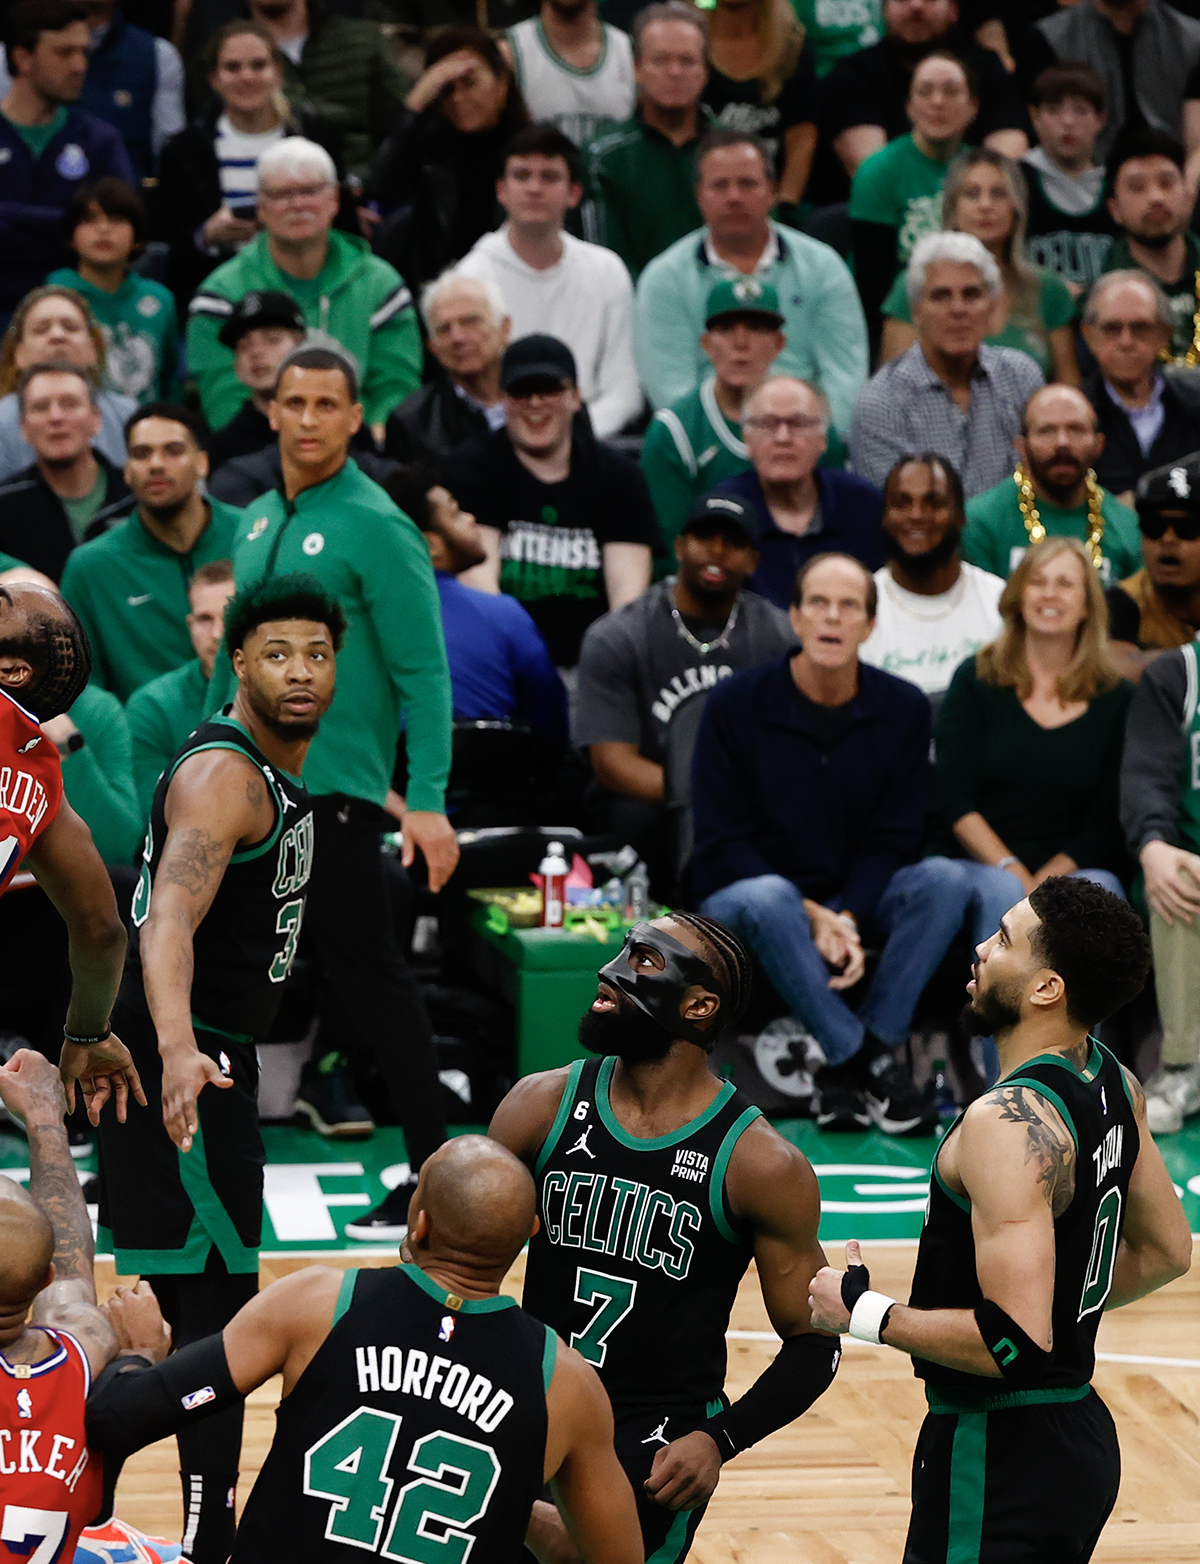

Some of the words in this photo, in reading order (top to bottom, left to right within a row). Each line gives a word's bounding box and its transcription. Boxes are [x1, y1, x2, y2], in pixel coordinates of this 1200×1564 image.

[573, 1100, 590, 1121] 6
[670, 1164, 707, 1183] PRINT
[675, 1149, 709, 1172] VISTA
[542, 1171, 702, 1280] CELTICS
[1077, 1185, 1122, 1324] 0
[570, 1266, 637, 1368] 7
[355, 1345, 514, 1433] HORFORD
[302, 1405, 502, 1564] 42
